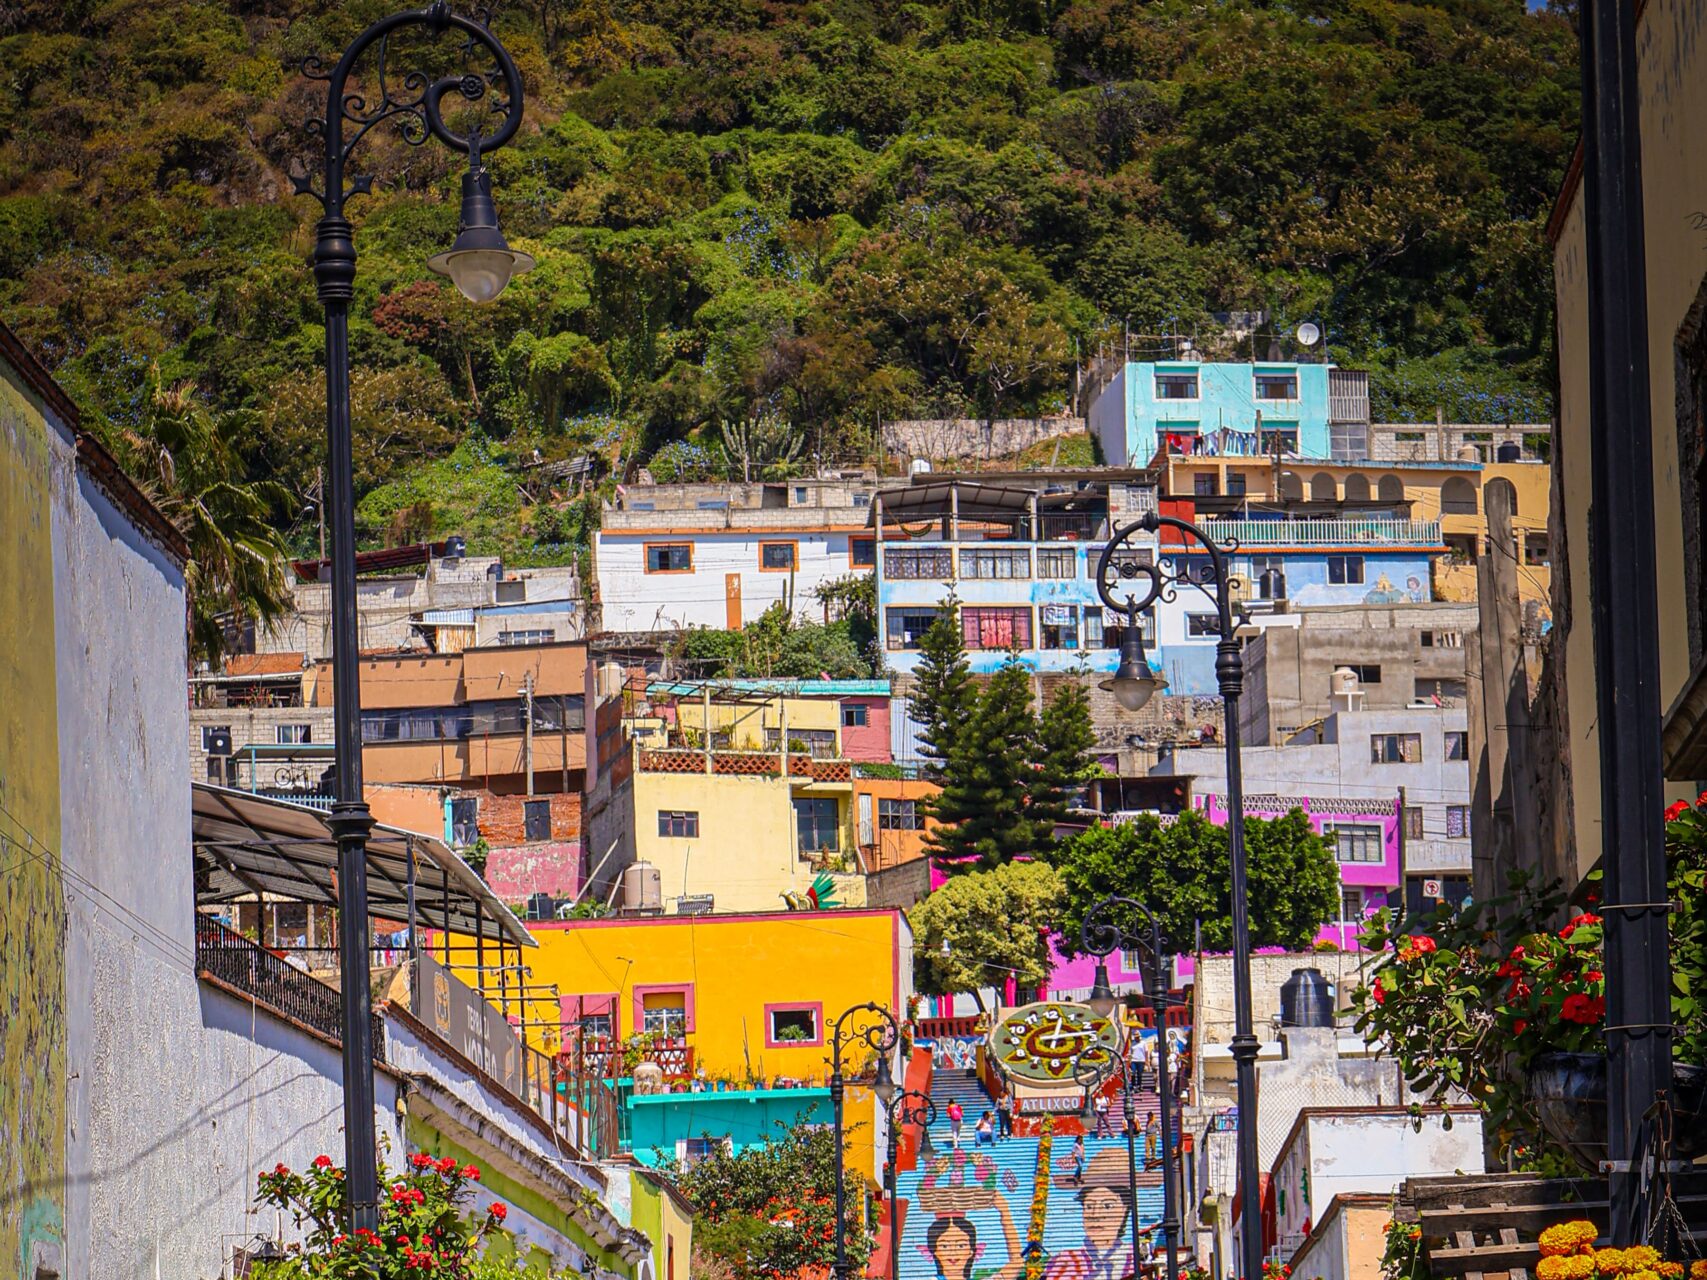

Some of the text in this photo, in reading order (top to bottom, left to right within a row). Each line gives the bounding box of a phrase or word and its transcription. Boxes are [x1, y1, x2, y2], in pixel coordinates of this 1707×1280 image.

[1025, 1013, 1038, 1025] 11
[1042, 1010, 1059, 1019] 12
[1068, 1013, 1075, 1021] 1
[1009, 1025, 1026, 1034] 10
[1082, 1021, 1092, 1029] 2
[1010, 1036, 1020, 1045] 9
[1089, 1033, 1098, 1042] 3
[1016, 1048, 1026, 1058] 8
[1030, 1056, 1040, 1065] 7
[1050, 1058, 1060, 1068] 6
[1021, 1097, 1079, 1110] ATLIXCO
